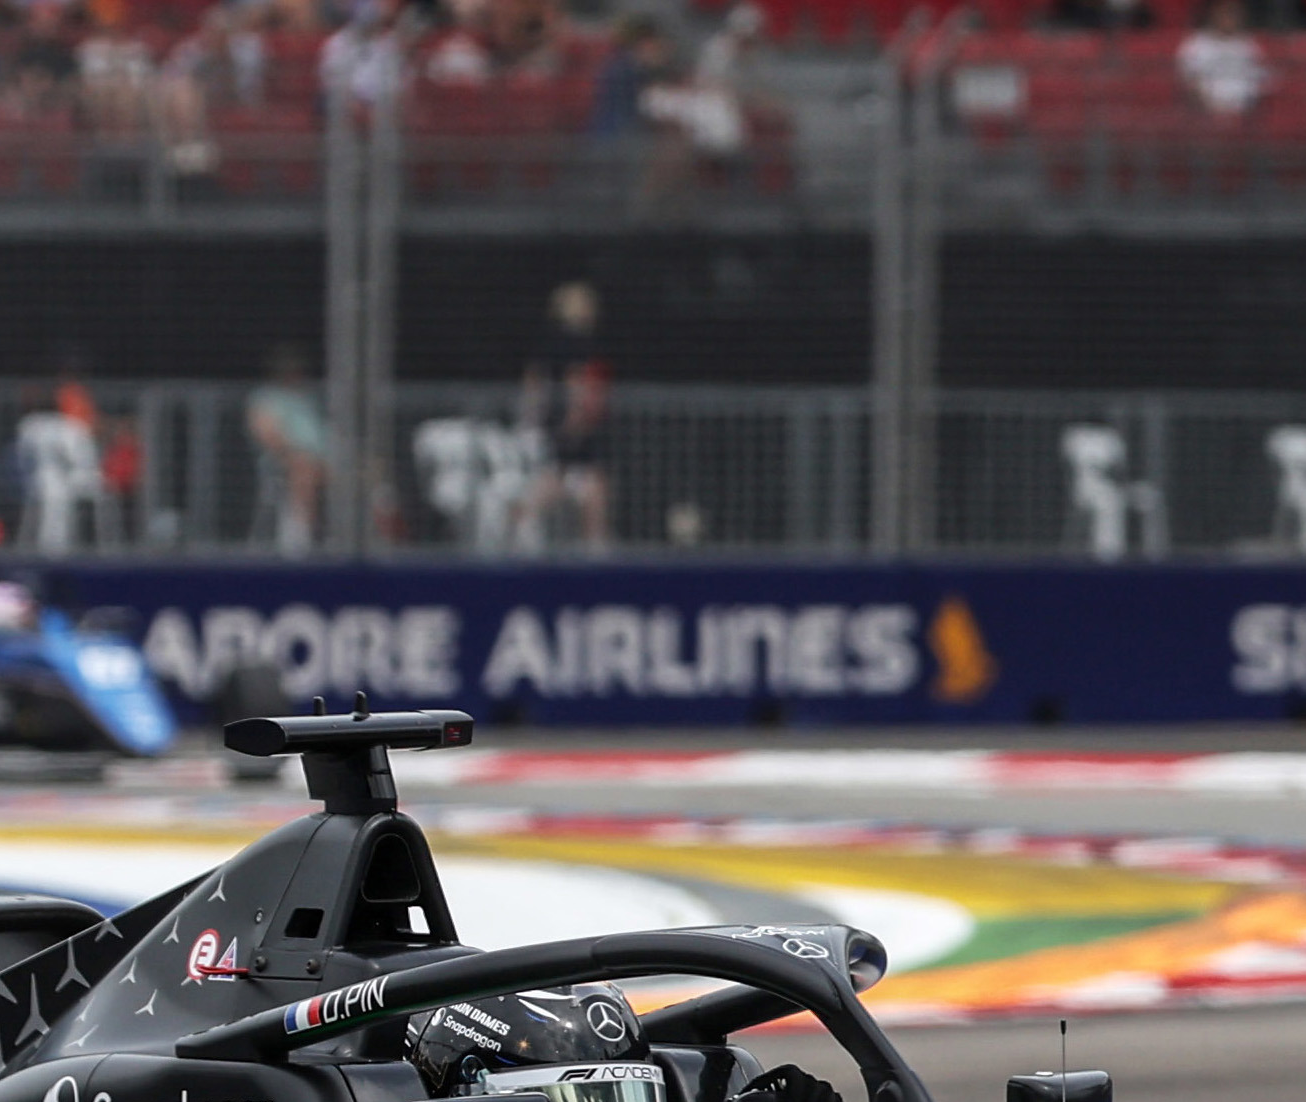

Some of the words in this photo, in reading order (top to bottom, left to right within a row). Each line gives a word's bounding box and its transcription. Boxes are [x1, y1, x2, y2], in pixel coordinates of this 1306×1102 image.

[483, 603, 918, 699] AIRLINES
[443, 1015, 502, 1052] Snapdragon
[470, 1008, 511, 1036] DAMES
[557, 1068, 597, 1082] F1
